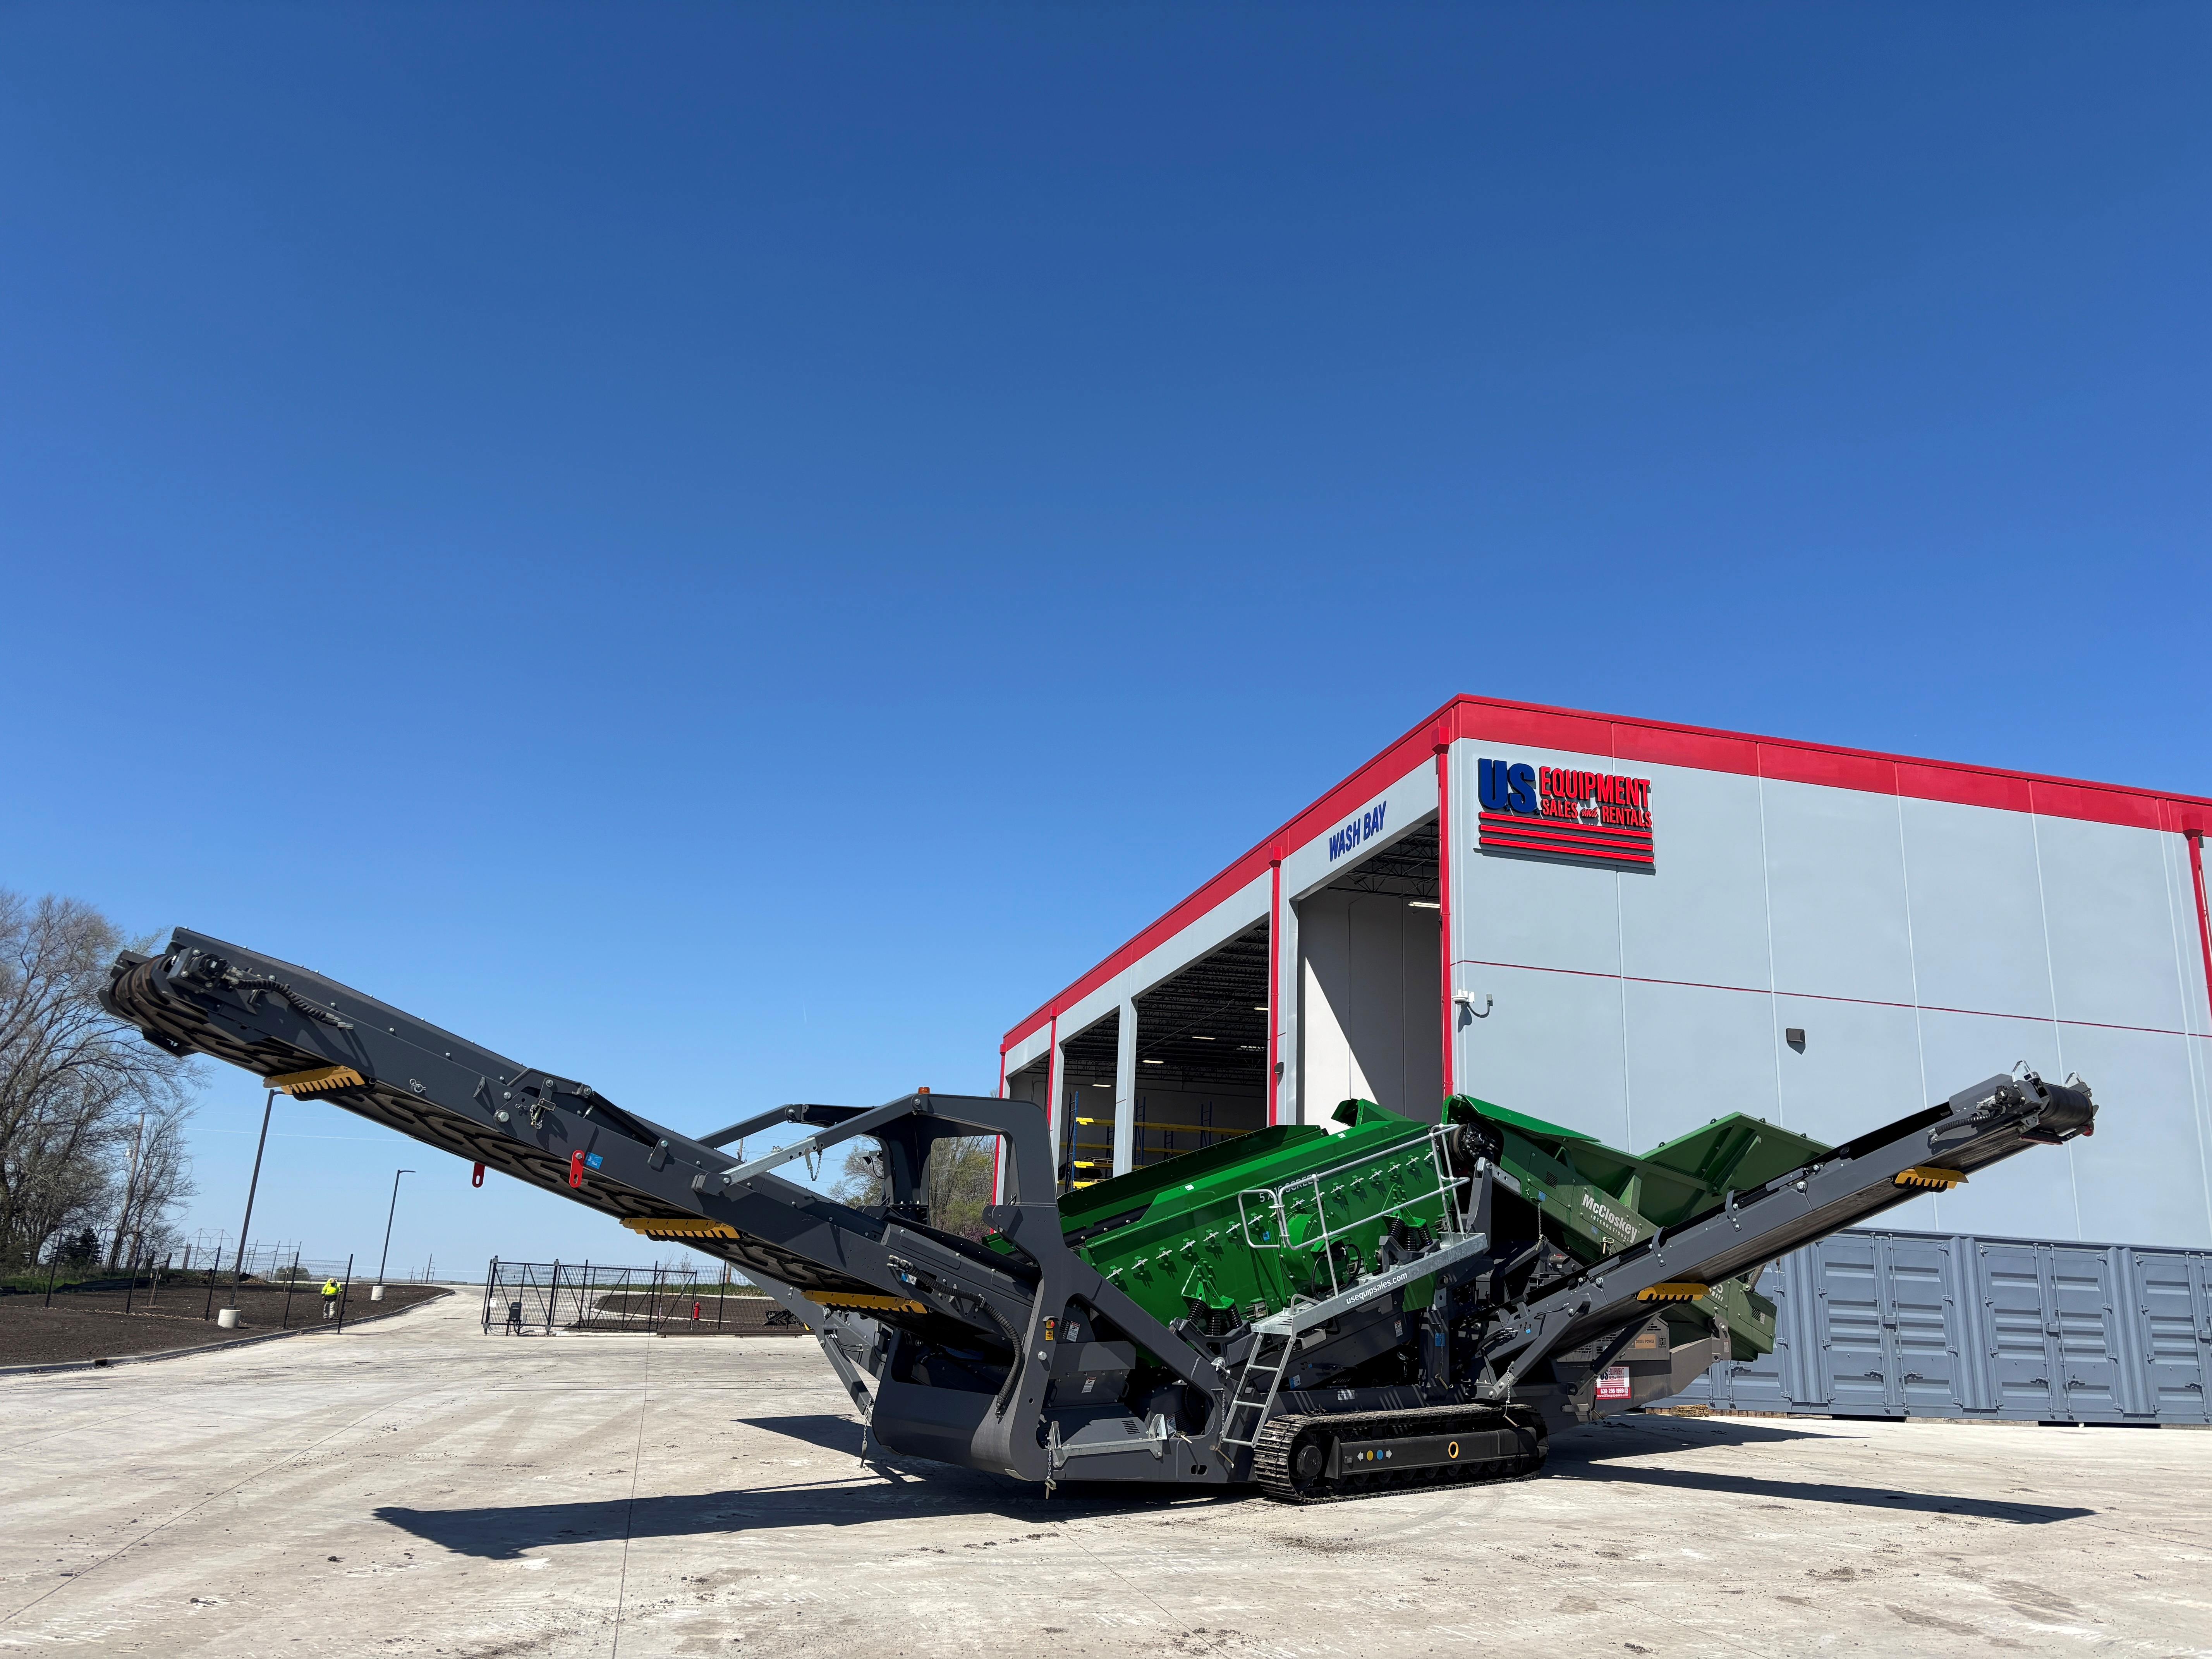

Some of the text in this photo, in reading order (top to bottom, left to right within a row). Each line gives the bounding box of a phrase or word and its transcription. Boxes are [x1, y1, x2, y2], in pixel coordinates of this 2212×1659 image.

[1539, 766, 1650, 808] EQUIPMENT
[1542, 798, 1652, 828] SALES and RENTALS
[1329, 800, 1387, 862] WASH BAY
[1259, 1192, 1265, 1202] 5
[1285, 1172, 1319, 1193] SCREE
[1582, 1194, 1638, 1243] McCloskey
[1590, 1214, 1630, 1242] INTERNATIONAL
[1346, 1272, 1408, 1305] usequipsales.com
